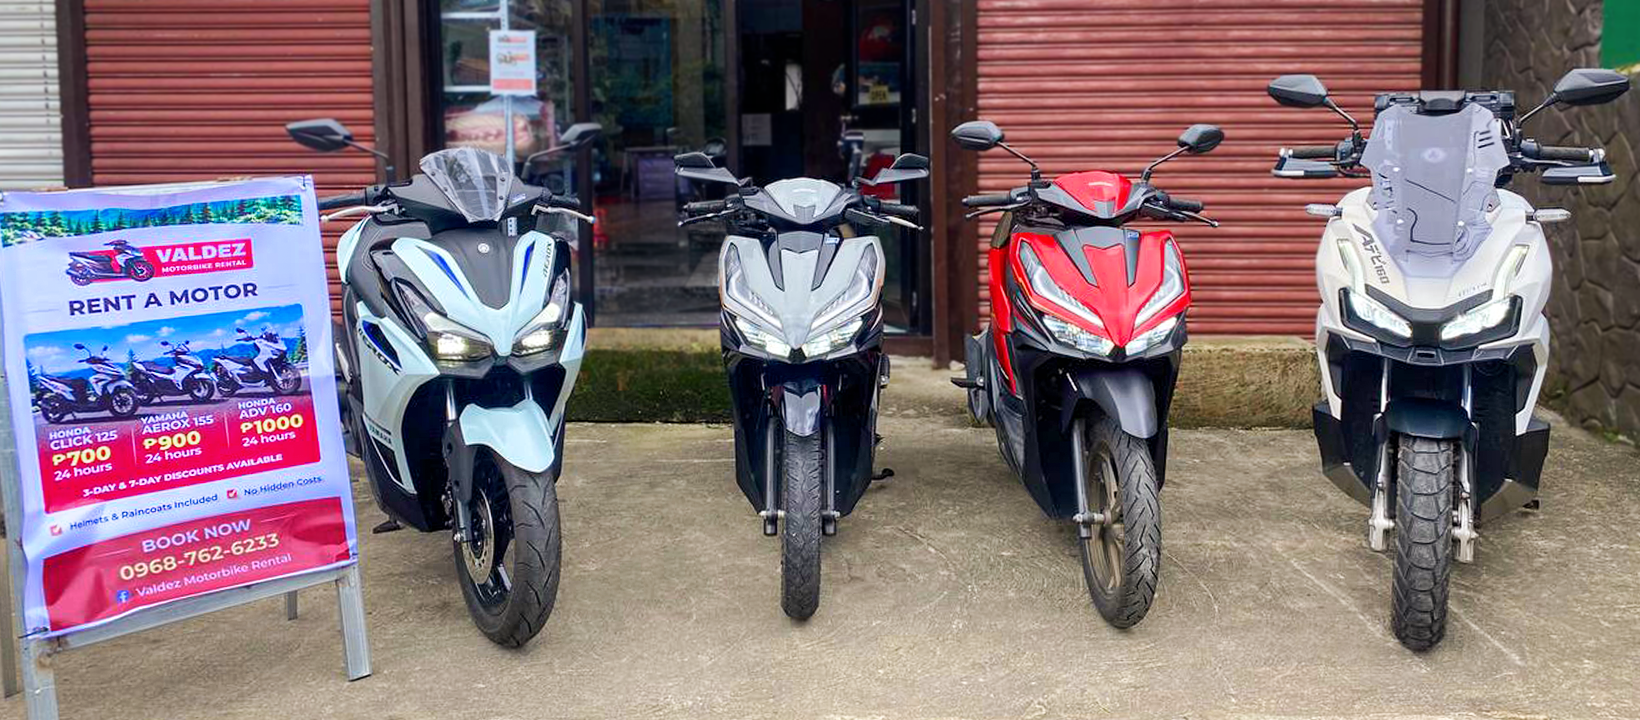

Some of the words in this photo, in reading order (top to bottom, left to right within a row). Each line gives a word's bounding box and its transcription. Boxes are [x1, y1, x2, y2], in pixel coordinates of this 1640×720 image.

[156, 243, 247, 263] VALDEZ
[161, 262, 213, 273] MOTORBIKE
[215, 259, 247, 269] RENTAL
[69, 294, 136, 316] RENT
[144, 292, 163, 308] A
[169, 282, 258, 306] MOTOR
[237, 397, 276, 410] HONDA
[239, 405, 268, 419] ADV
[270, 402, 292, 414] 160
[141, 410, 188, 424] YAMAHA
[142, 418, 190, 435] AEROX
[193, 414, 214, 427] 155
[49, 426, 91, 440] HONDA
[50, 434, 94, 451] CLICK
[95, 430, 118, 442] 125
[242, 437, 259, 447] 24
[261, 431, 296, 444] hours
[144, 452, 162, 464] 24
[165, 447, 202, 461] hours
[54, 469, 71, 481] 24
[74, 463, 113, 477] hours
[82, 483, 117, 497] 3-DAY
[118, 481, 127, 490] &
[129, 475, 162, 488] 7-DAY
[164, 463, 226, 482] DISCOUNTS
[226, 453, 283, 470] AVAILABLE
[244, 487, 257, 497] No
[260, 480, 295, 493] Hidden
[297, 475, 322, 487] Costs
[70, 514, 109, 530] Helmets
[111, 512, 118, 521] &
[121, 503, 173, 519] Raincoats
[174, 493, 218, 509] Included
[142, 529, 200, 553] BOOK
[204, 518, 251, 540] NOW
[120, 533, 279, 580] 0968-762-6233
[135, 579, 181, 597] Valdez
[184, 563, 249, 586] Motorbike
[251, 553, 292, 571] Rental
